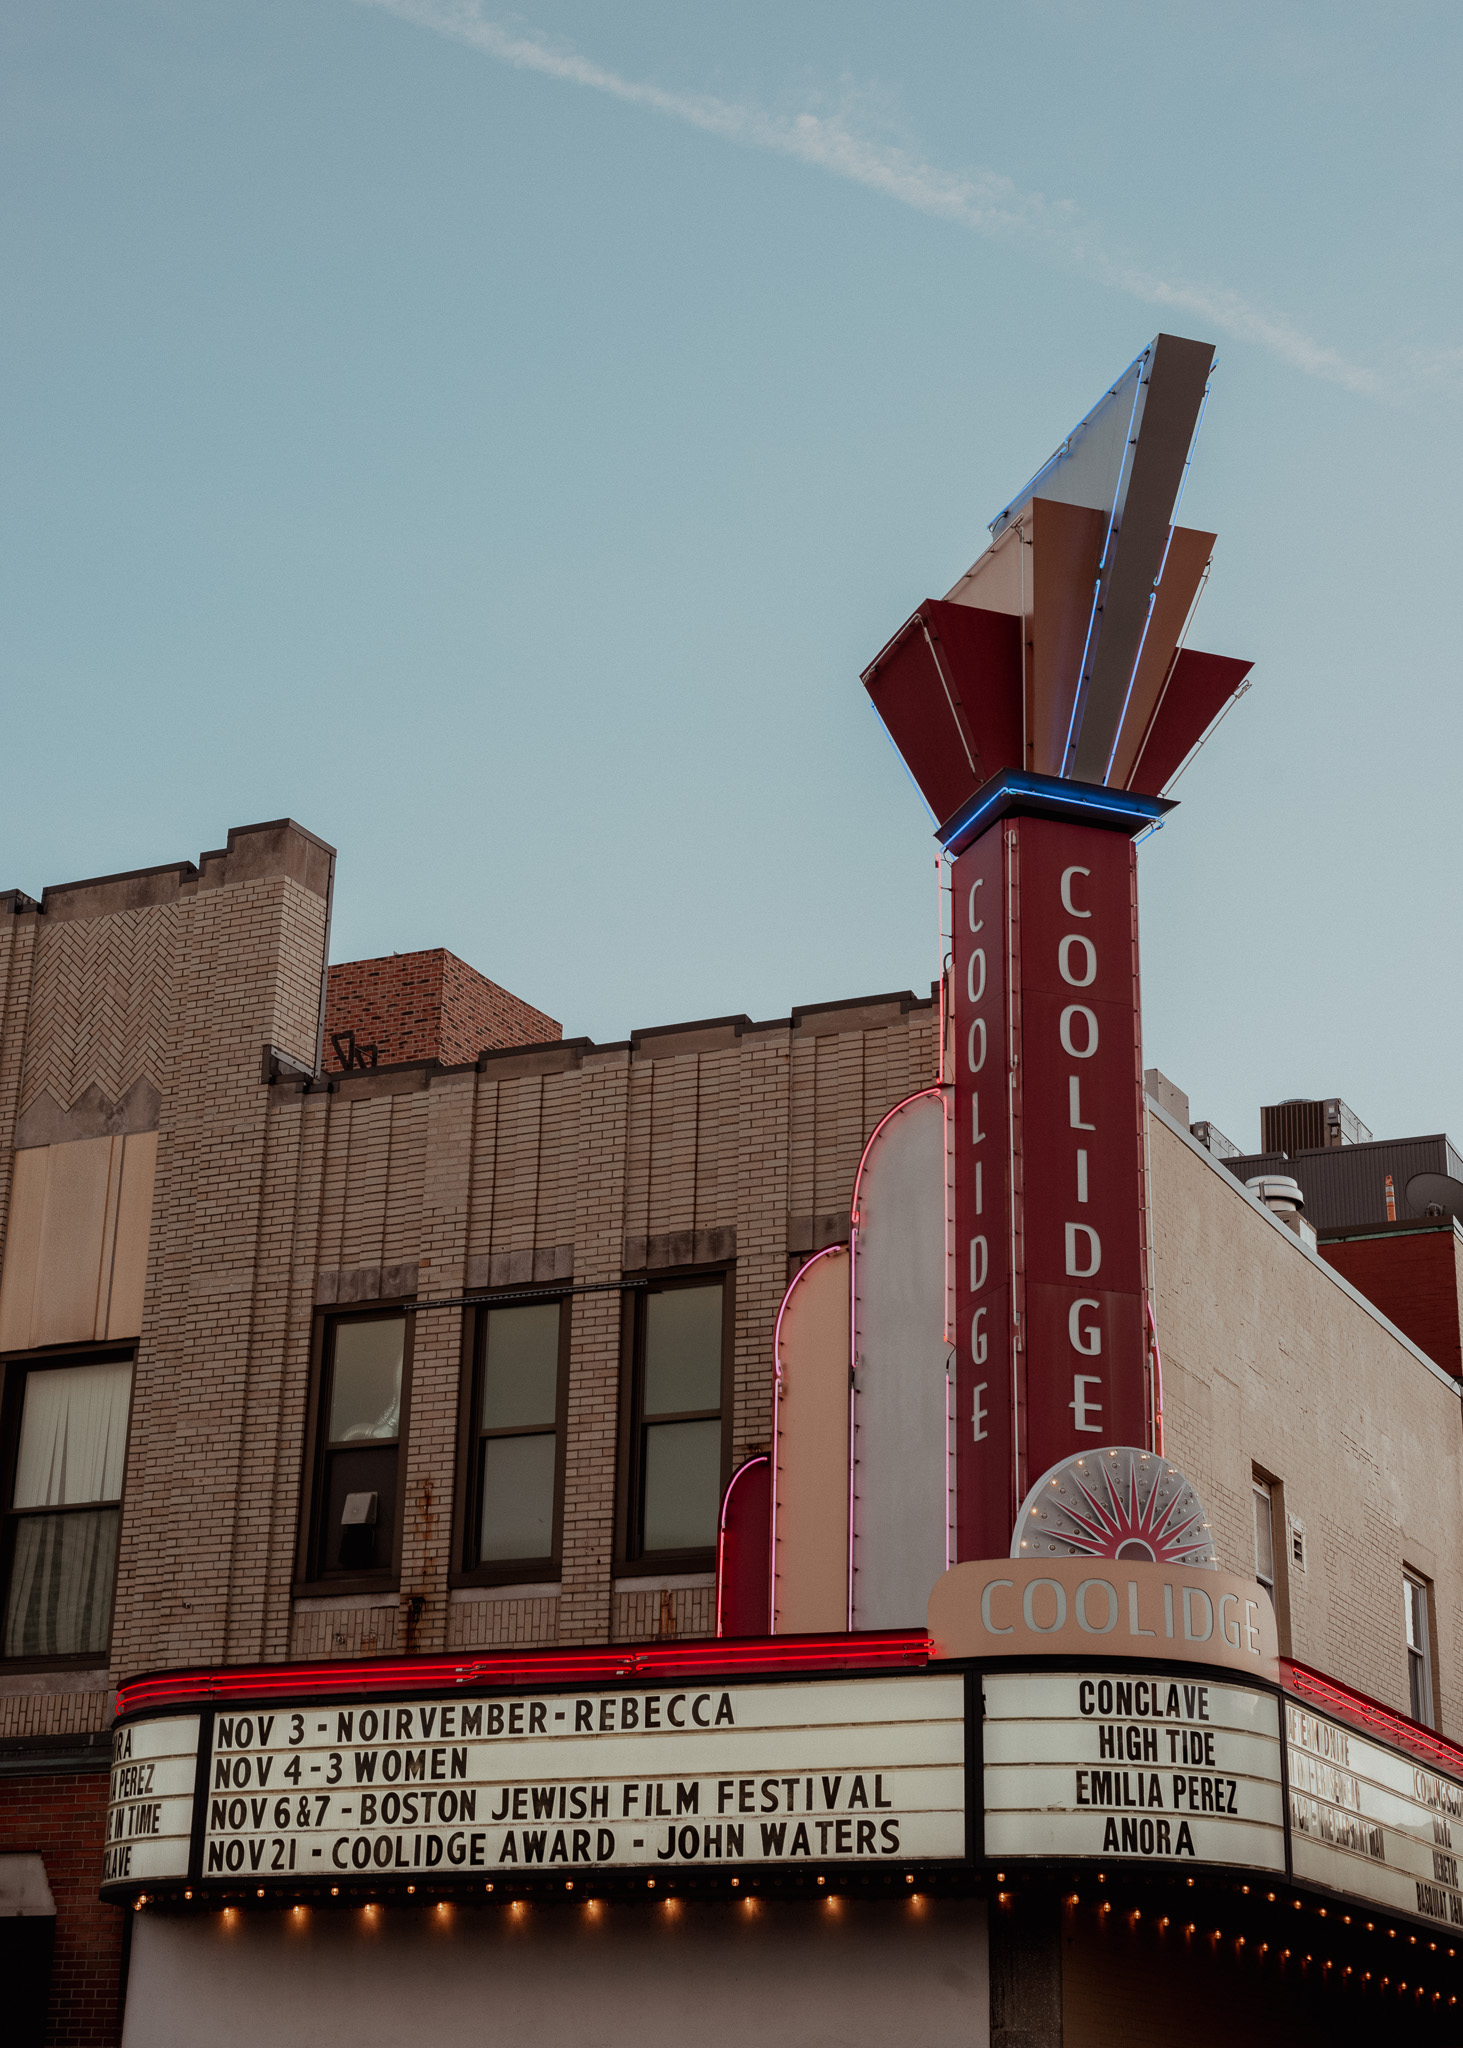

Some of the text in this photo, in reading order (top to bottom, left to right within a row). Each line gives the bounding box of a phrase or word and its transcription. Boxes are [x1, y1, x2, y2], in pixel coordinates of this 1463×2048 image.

[967, 878, 988, 1442] COOLIDGE
[1058, 865, 1103, 1432] COOLIDGE
[981, 1577, 1261, 1656] COOLIDGE
[1079, 1680, 1210, 1721] CONCLAVE
[217, 1715, 275, 1749] NOV
[288, 1714, 304, 1745] 3
[1099, 1725, 1216, 1767] HIGH TIDE
[118, 1763, 155, 1799] PEREZ
[215, 1755, 273, 1789] NOV
[354, 1747, 468, 1783] WOMEN
[211, 1797, 267, 1831] NOV
[274, 1795, 331, 1829] 6&7
[360, 1790, 477, 1826] BOSTON
[492, 1785, 608, 1822] JEWISH
[622, 1782, 699, 1817] FILM
[717, 1774, 892, 1814] FESTIVAL
[1076, 1770, 1238, 1815] EMILIA PEREZ
[114, 1807, 125, 1839] IN
[128, 1803, 161, 1836] TIME
[1103, 1816, 1196, 1856] ANORA
[332, 1832, 486, 1870] COOLIDGE
[500, 1828, 615, 1864] AWARD
[657, 1823, 744, 1861] JOHN
[760, 1819, 900, 1857] WATERS
